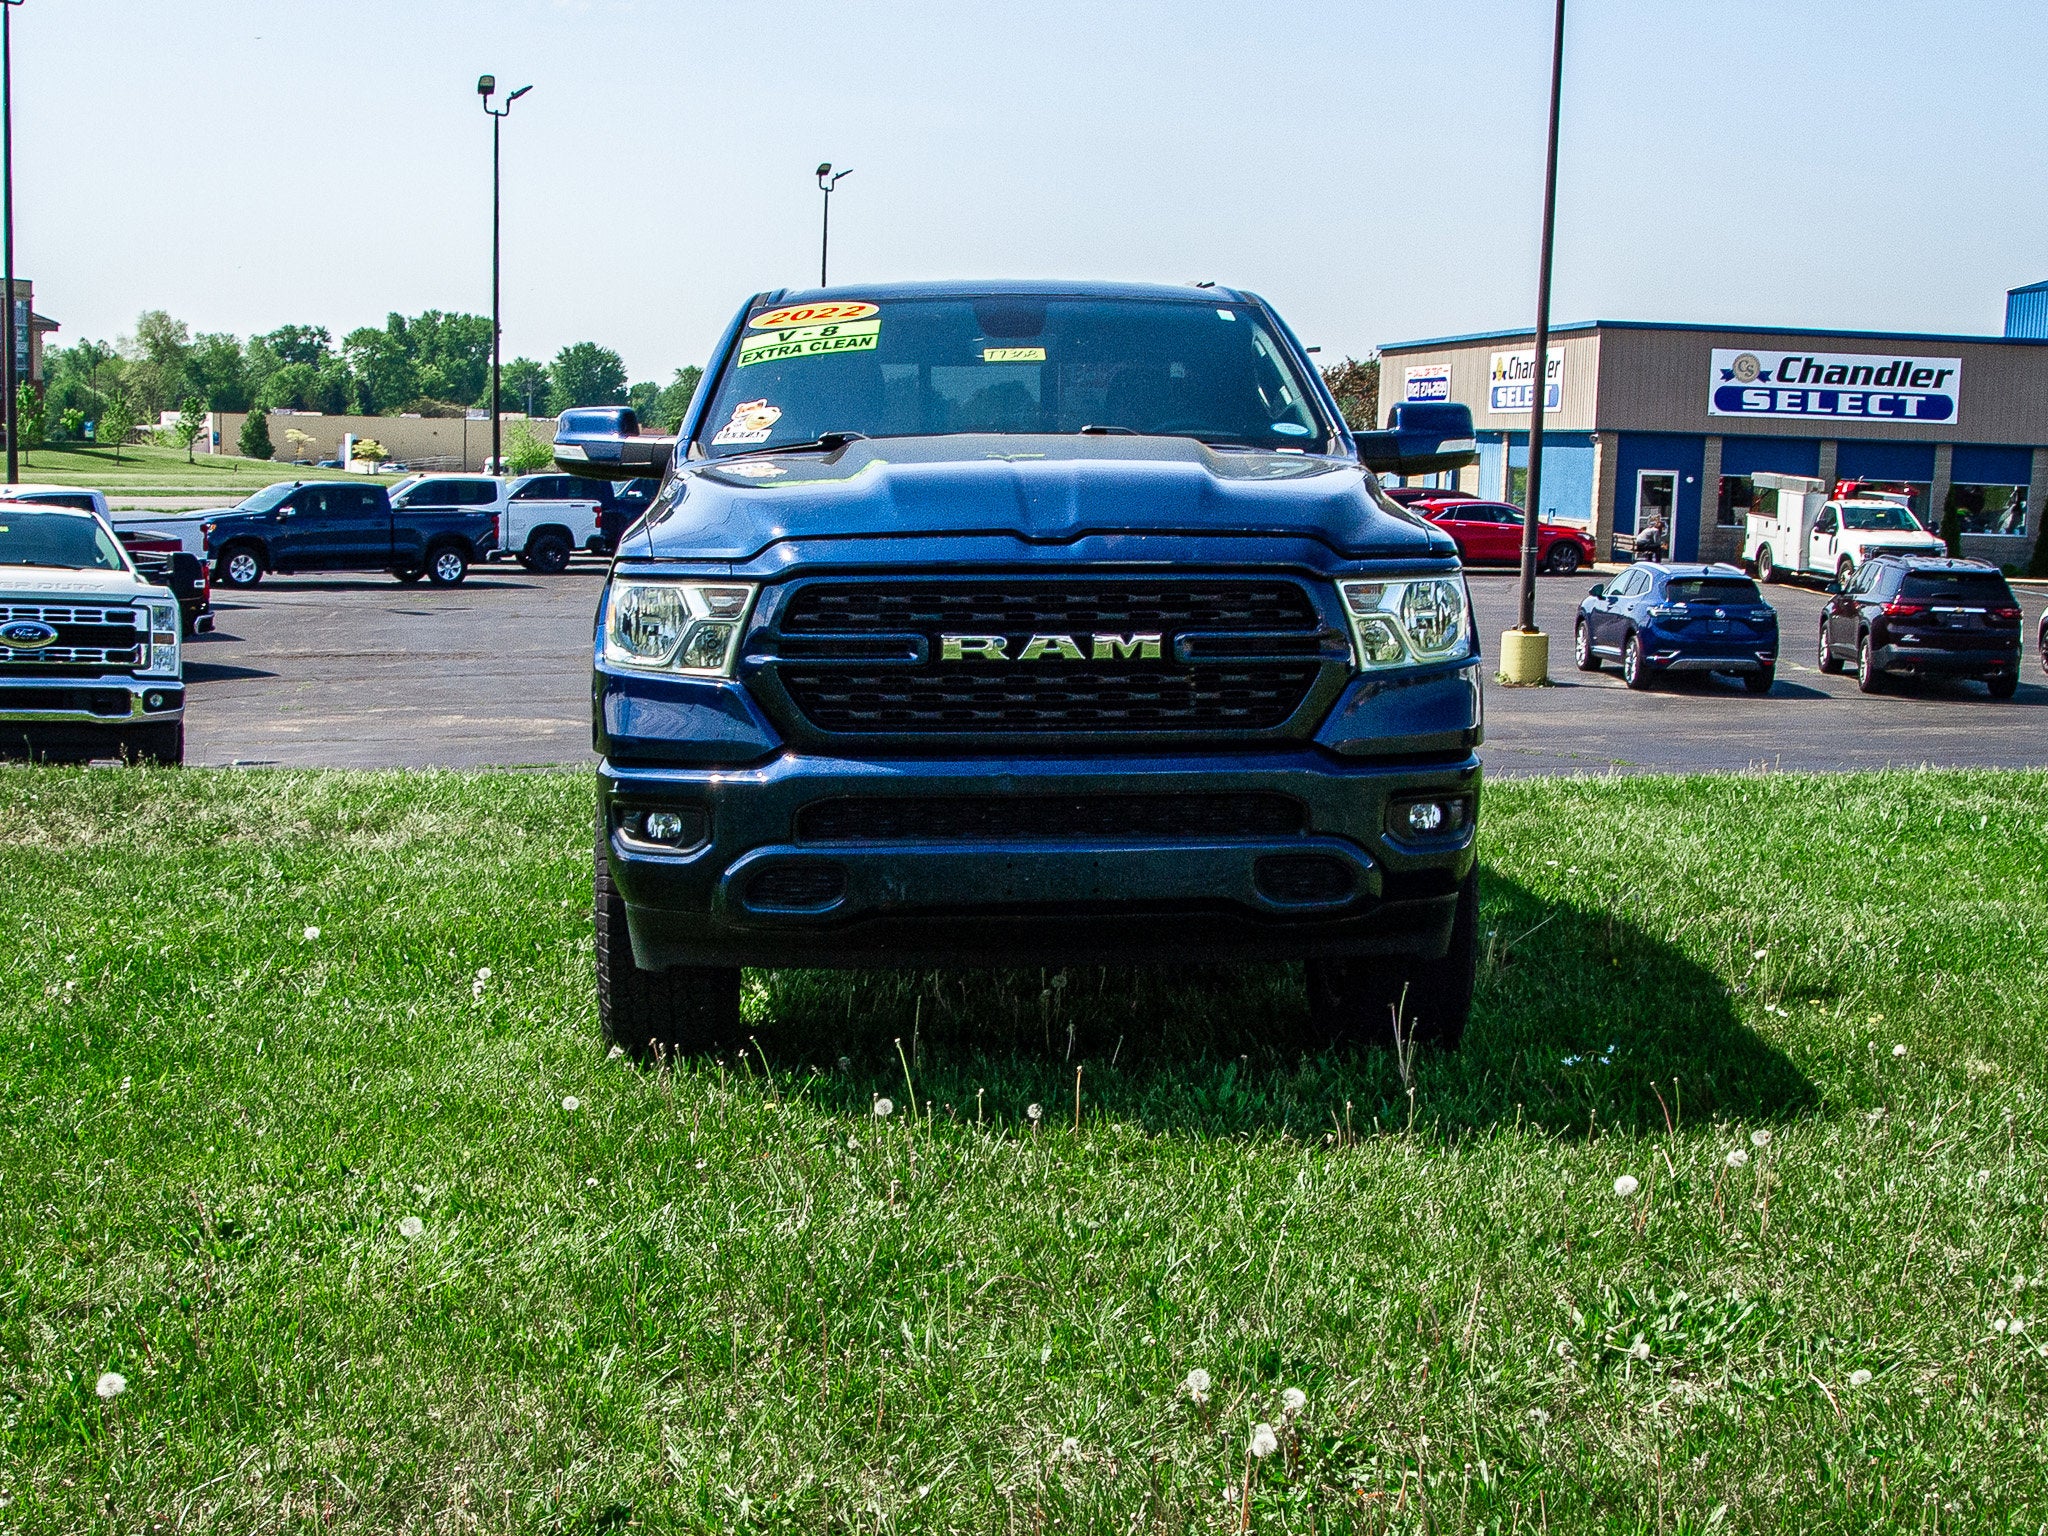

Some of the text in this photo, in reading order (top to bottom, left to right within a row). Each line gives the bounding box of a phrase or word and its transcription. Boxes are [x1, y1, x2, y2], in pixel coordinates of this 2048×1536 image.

[763, 305, 867, 326] 2022
[741, 336, 873, 364] EXTRA CLEAN
[1508, 356, 1561, 380] Chaner
[1776, 355, 1954, 389] Chandler
[1497, 385, 1553, 408] SELET
[1742, 388, 1926, 417] SELECT
[12, 627, 42, 640] Ford
[941, 633, 1163, 660] RAM
